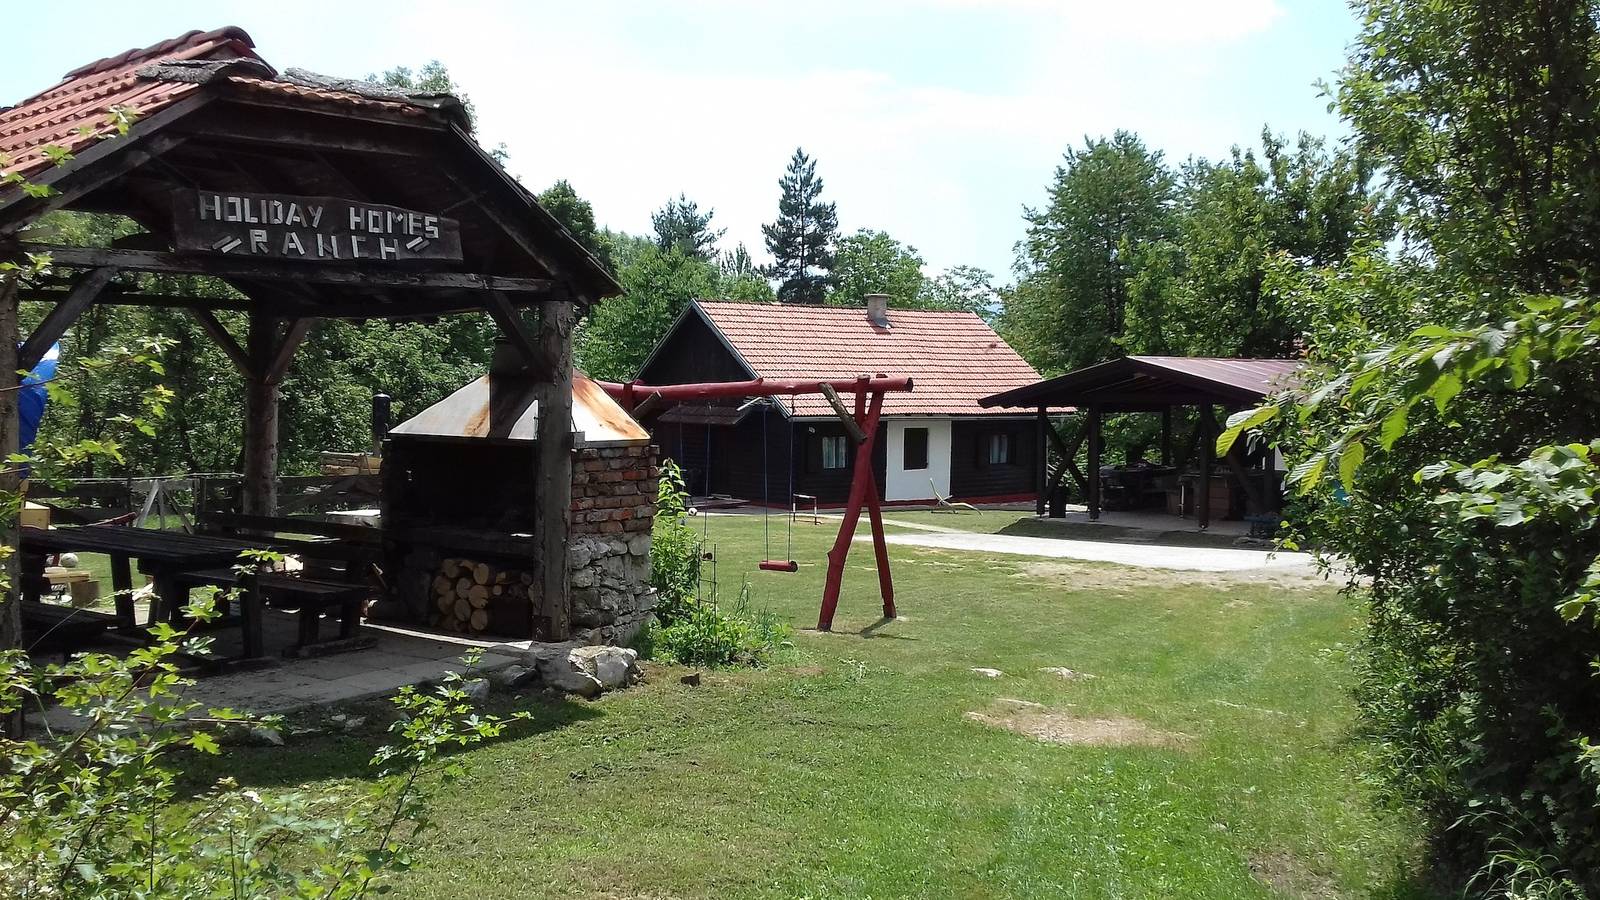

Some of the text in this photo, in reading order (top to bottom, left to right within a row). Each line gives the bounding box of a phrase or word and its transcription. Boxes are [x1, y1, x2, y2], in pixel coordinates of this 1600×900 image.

[199, 194, 439, 239] HOLIDAY HOMES
[250, 229, 400, 260] RANCH
